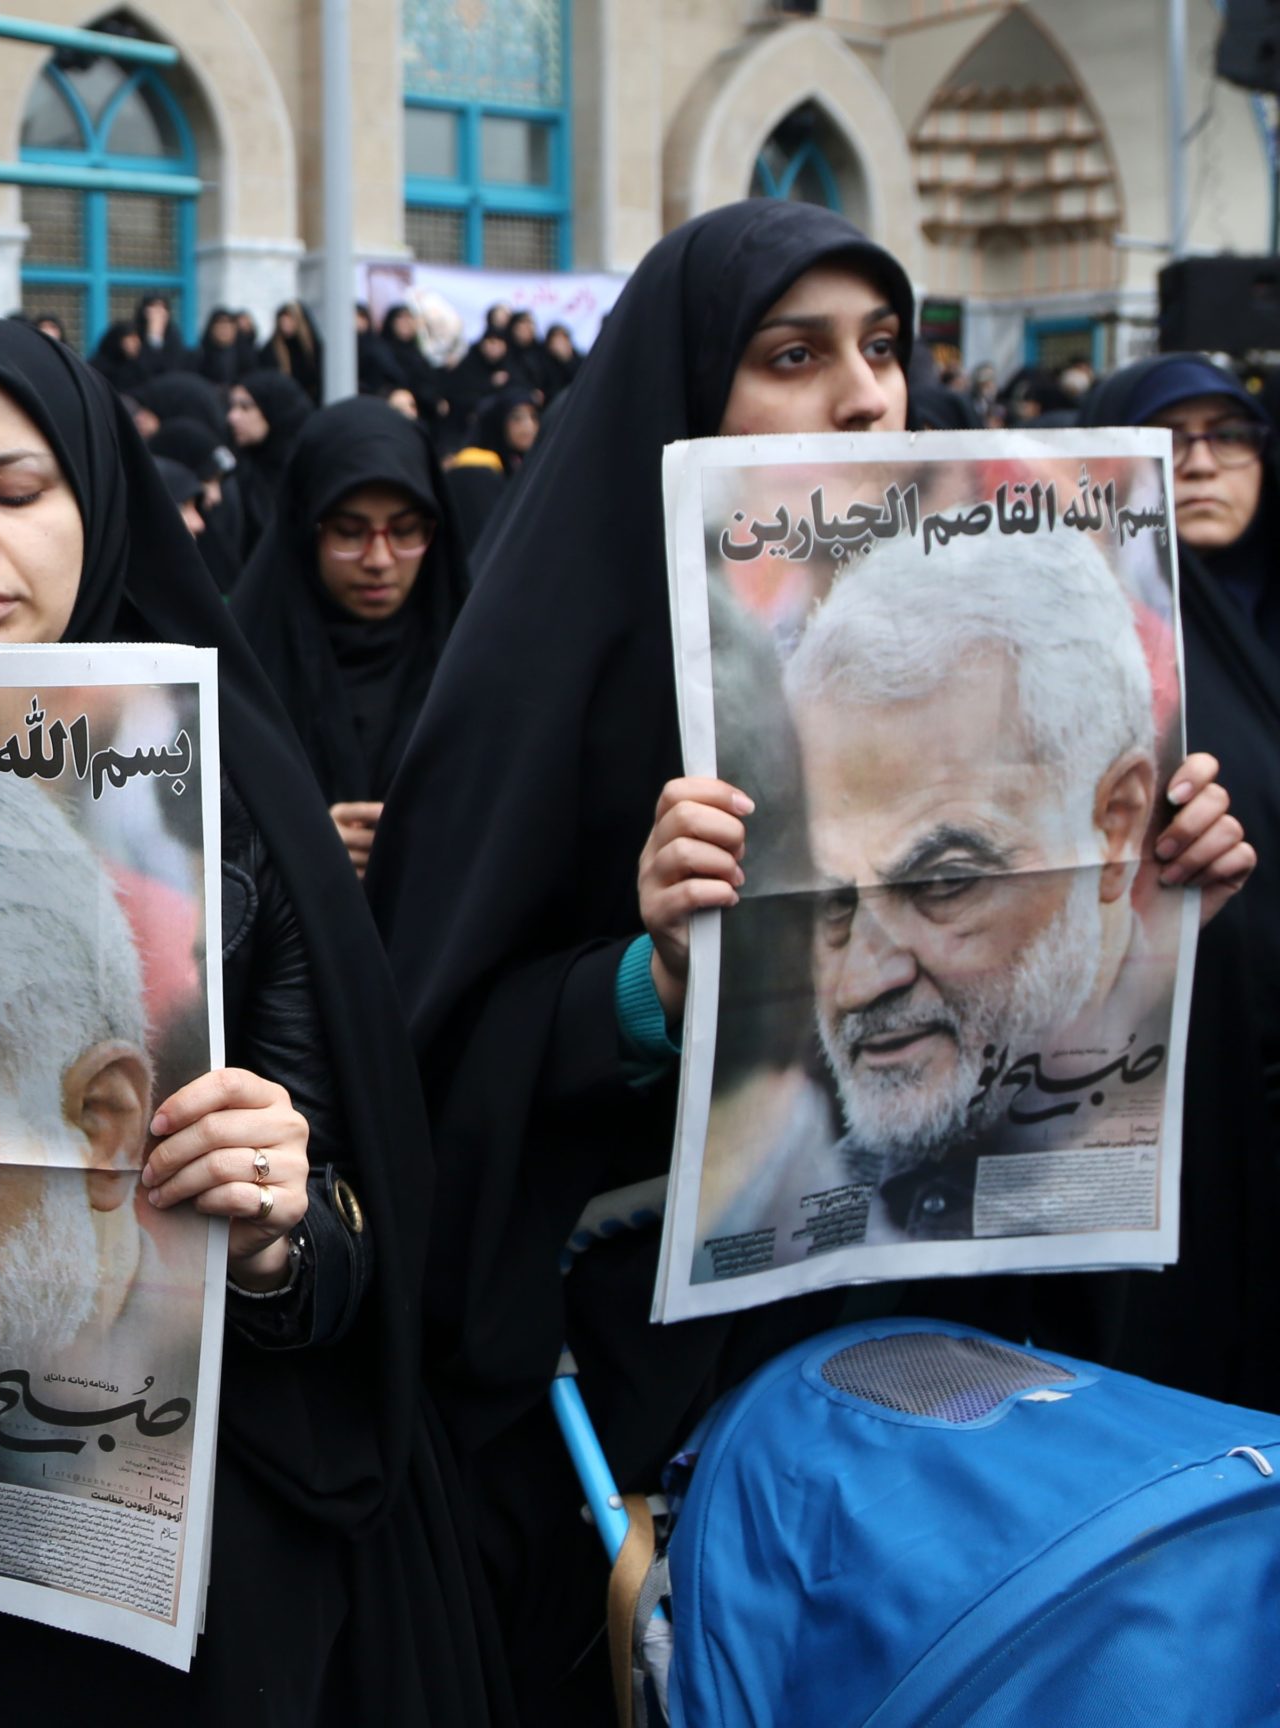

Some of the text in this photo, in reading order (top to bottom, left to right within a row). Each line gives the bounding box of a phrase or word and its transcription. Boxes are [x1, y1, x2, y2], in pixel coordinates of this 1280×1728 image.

[720, 480, 919, 560] الجبارین
[922, 480, 1055, 555] القاصم
[91, 728, 193, 800] بسم
